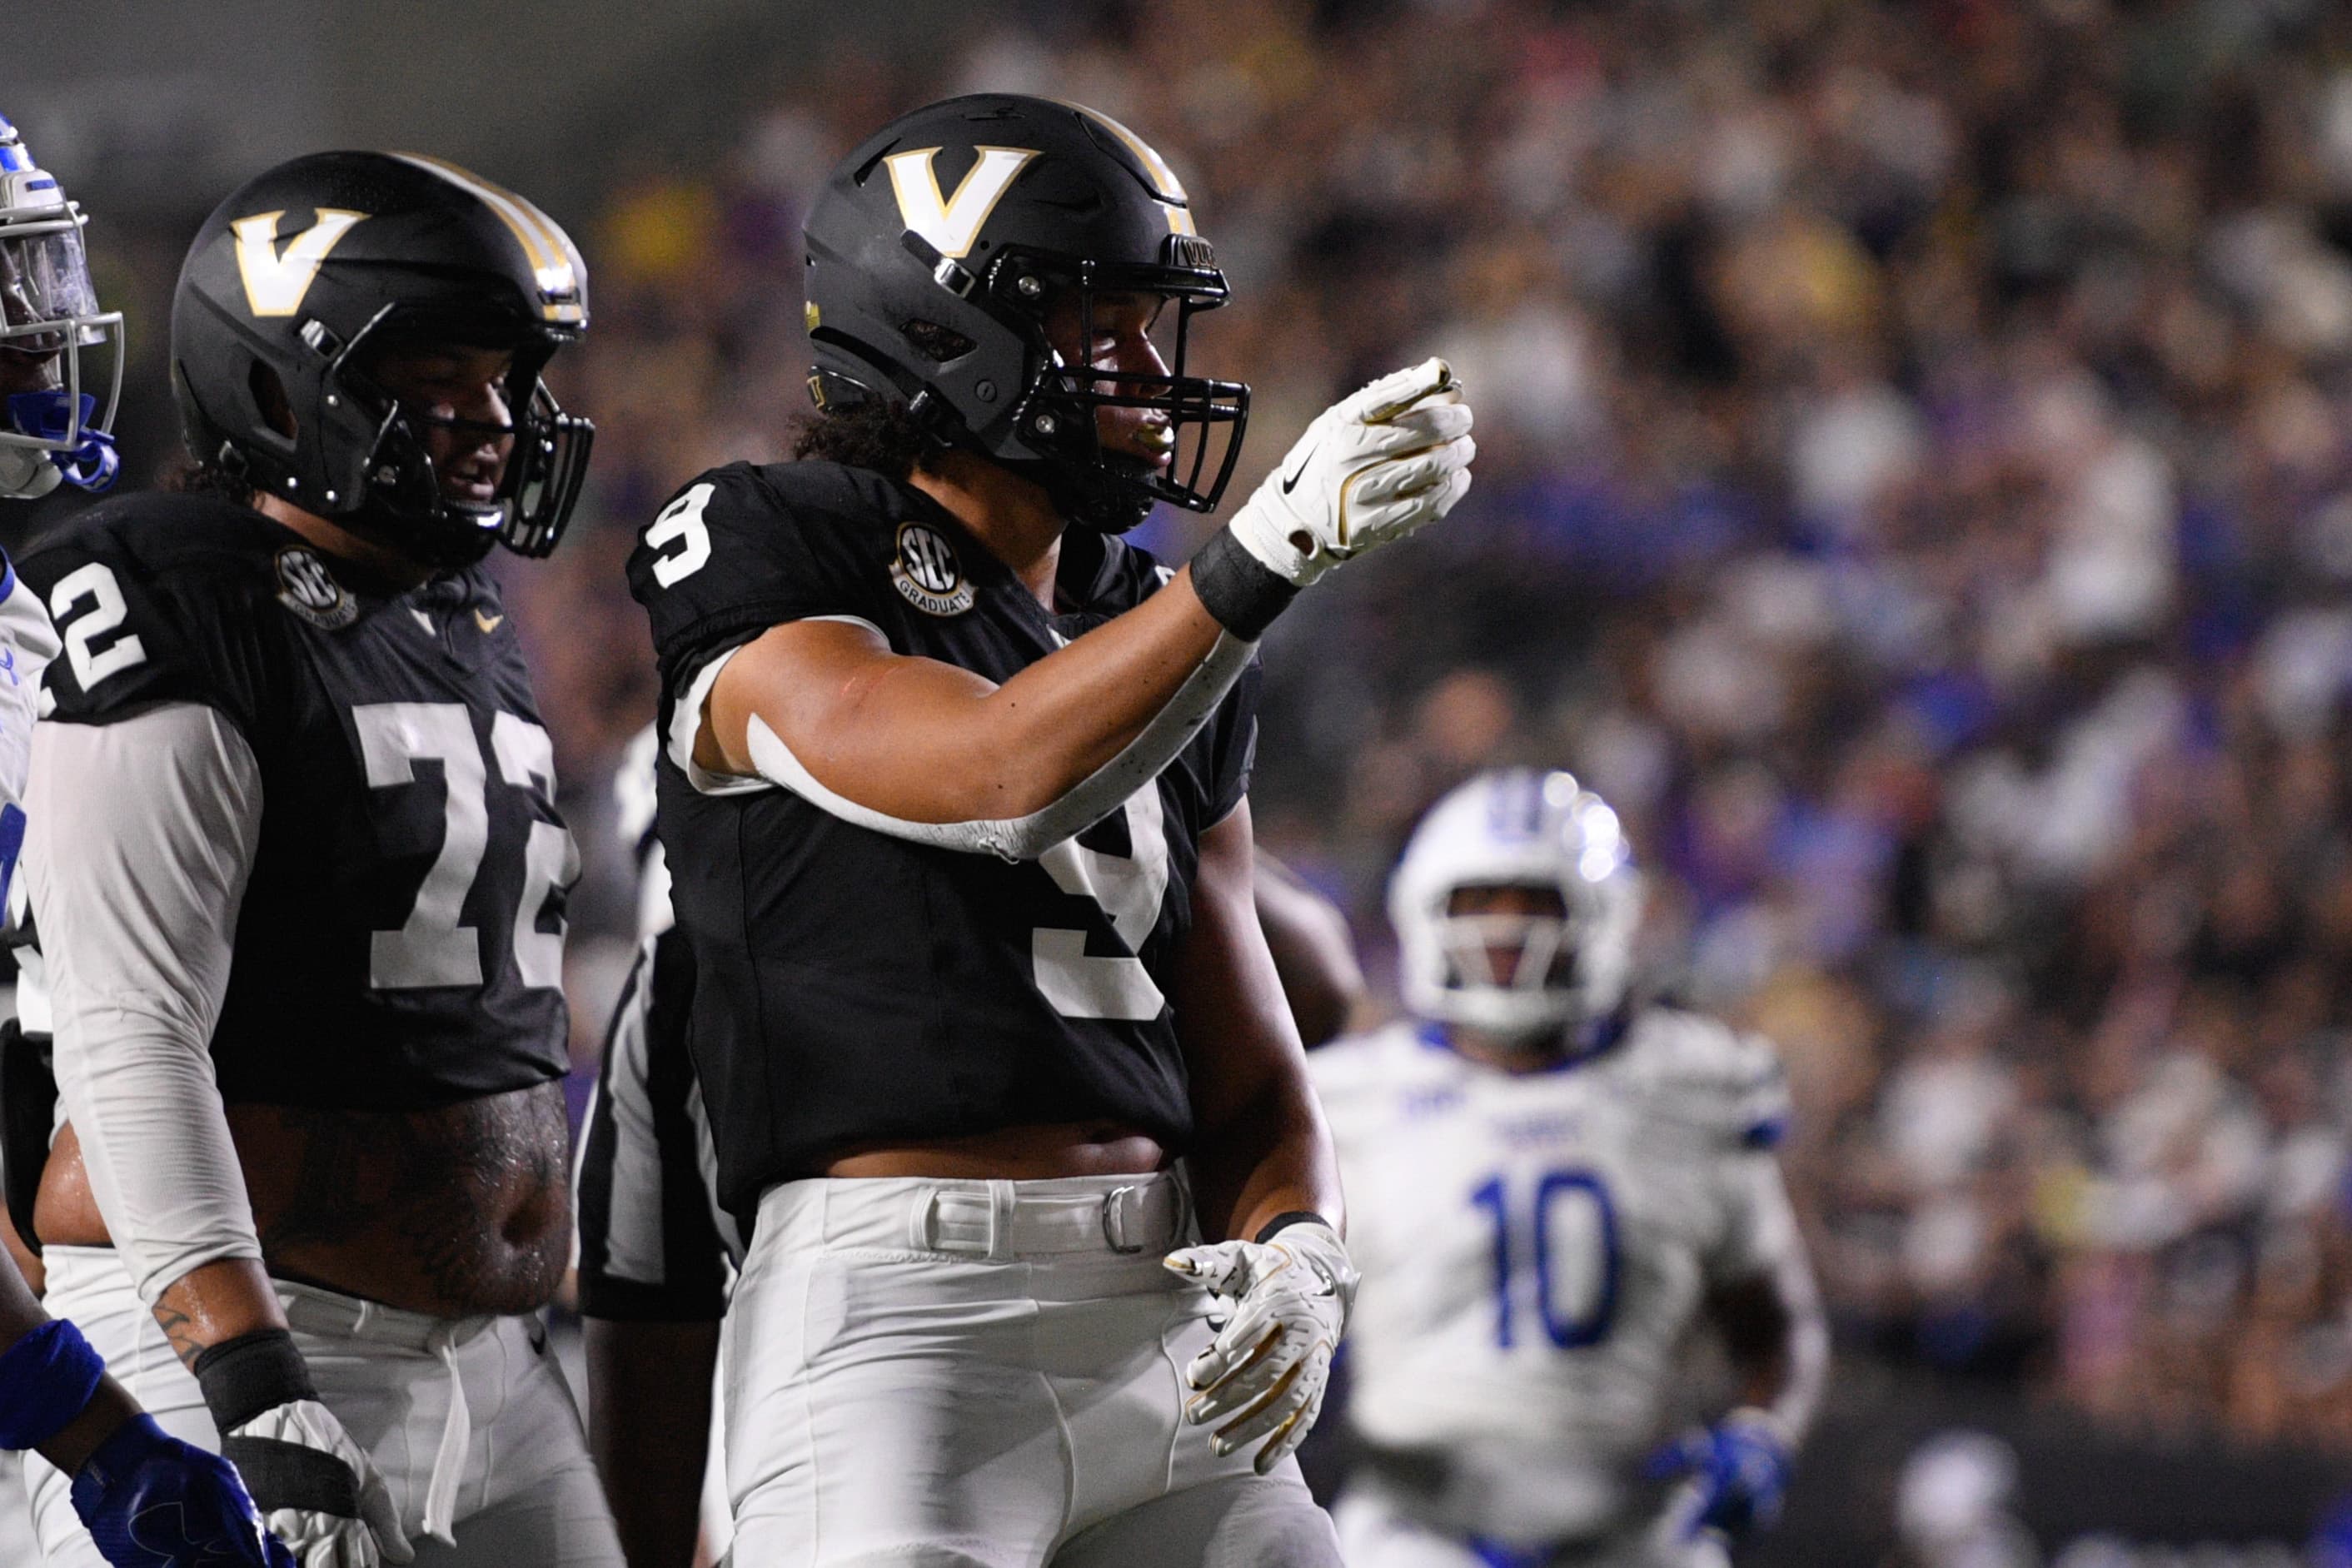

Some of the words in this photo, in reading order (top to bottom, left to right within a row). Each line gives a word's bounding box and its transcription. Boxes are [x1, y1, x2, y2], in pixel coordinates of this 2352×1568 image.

[881, 145, 1046, 259] V
[230, 207, 372, 317] V
[645, 482, 716, 590] 9
[901, 526, 955, 590] SEC
[351, 701, 582, 995] 72
[1031, 774, 1169, 1021] 9
[1468, 1171, 1617, 1351] 10
